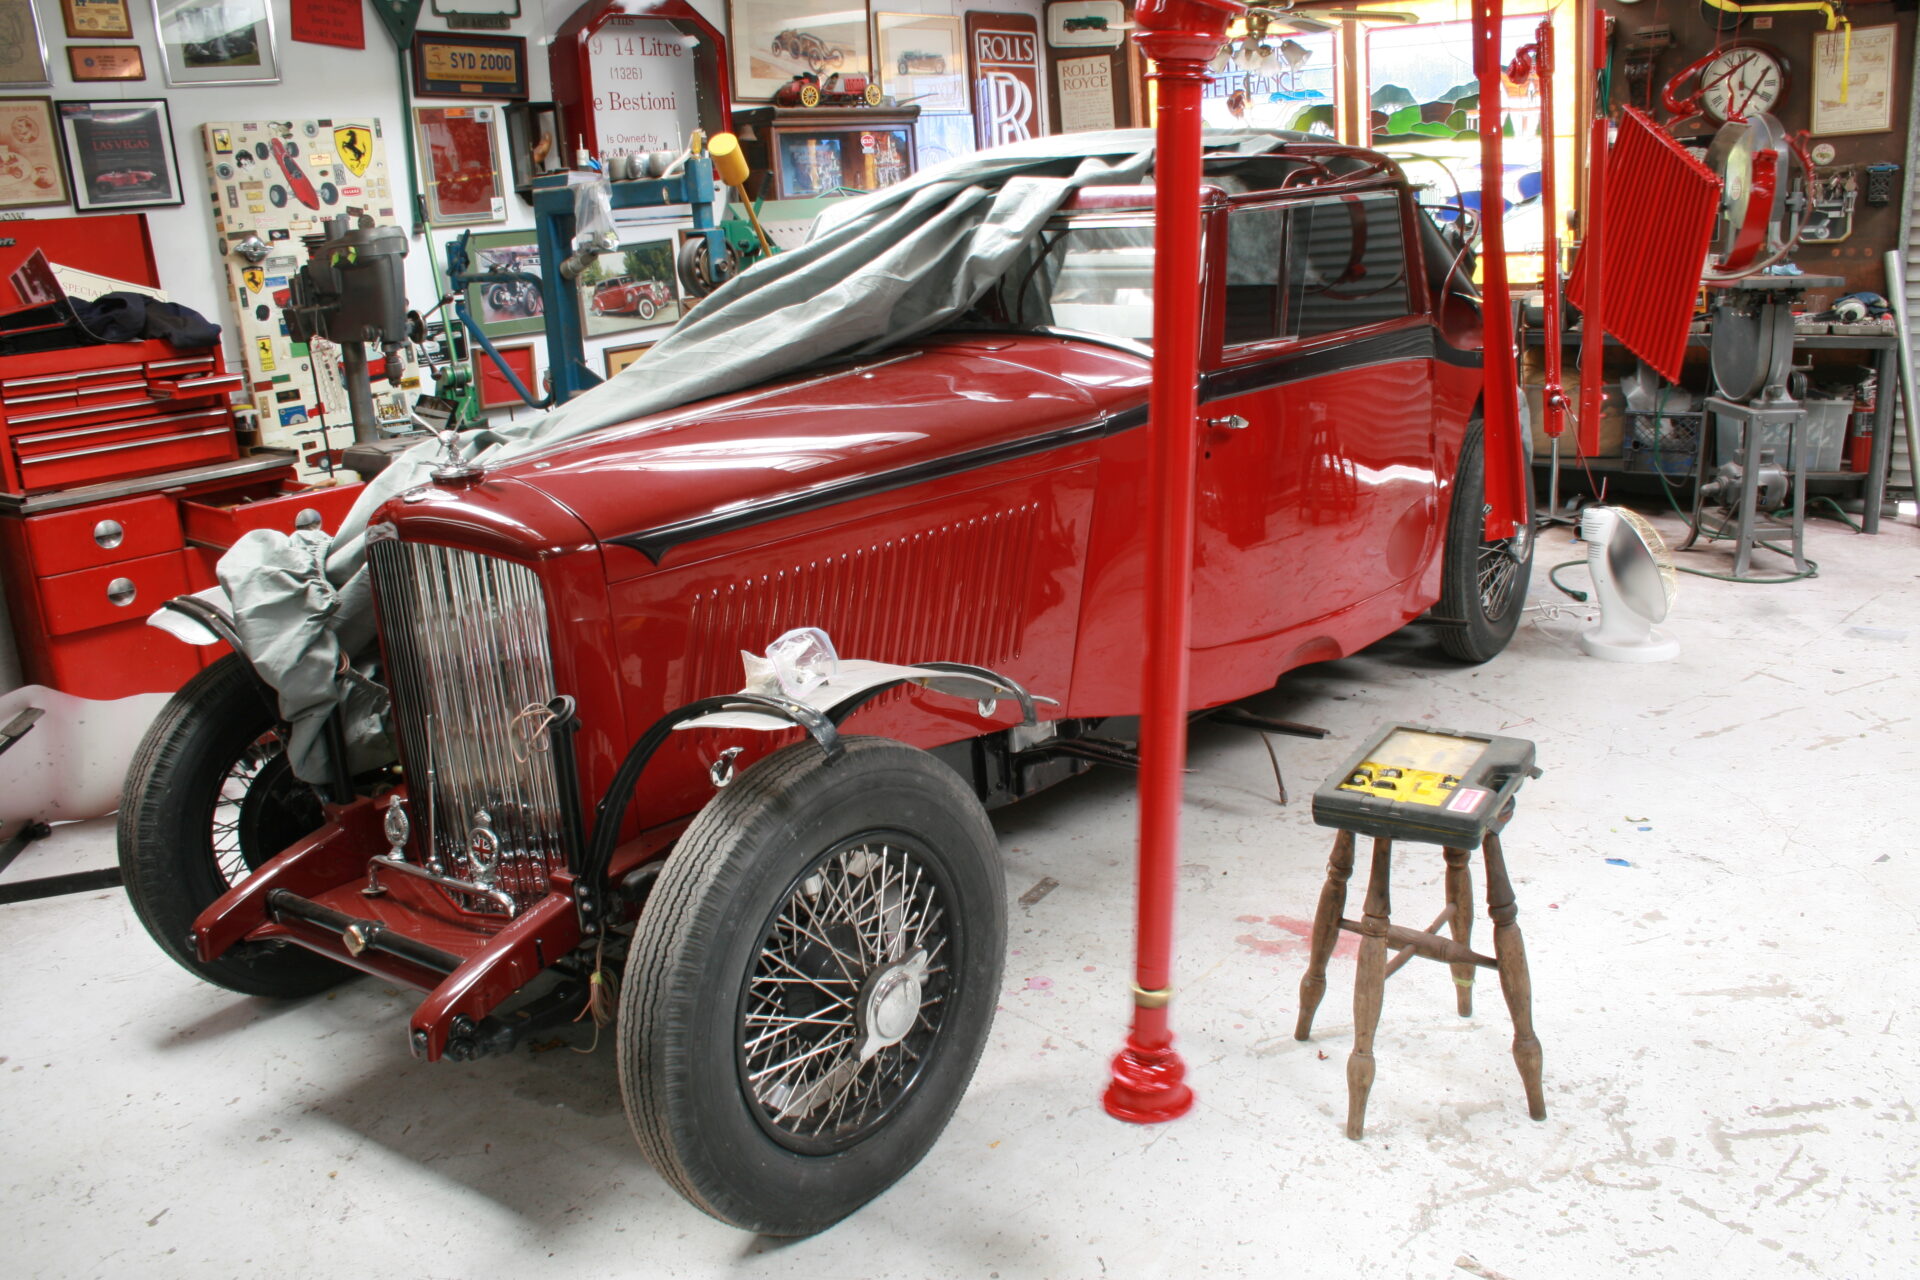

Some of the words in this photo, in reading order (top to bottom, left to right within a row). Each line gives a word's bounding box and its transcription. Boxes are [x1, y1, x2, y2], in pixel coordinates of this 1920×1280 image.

[639, 36, 682, 57] Litre
[980, 35, 1033, 62] ROLLS
[450, 52, 476, 69] SYD
[480, 54, 512, 71] 2000
[1062, 62, 1108, 77] ROLLS
[610, 66, 642, 80] (1326)
[1063, 75, 1109, 91] ROYCE
[608, 91, 677, 111] Bestioni
[91, 140, 113, 151] LAS
[114, 139, 150, 150] VEGAS
[606, 134, 614, 144] Is
[616, 133, 646, 143] Owned
[648, 133, 658, 145] by
